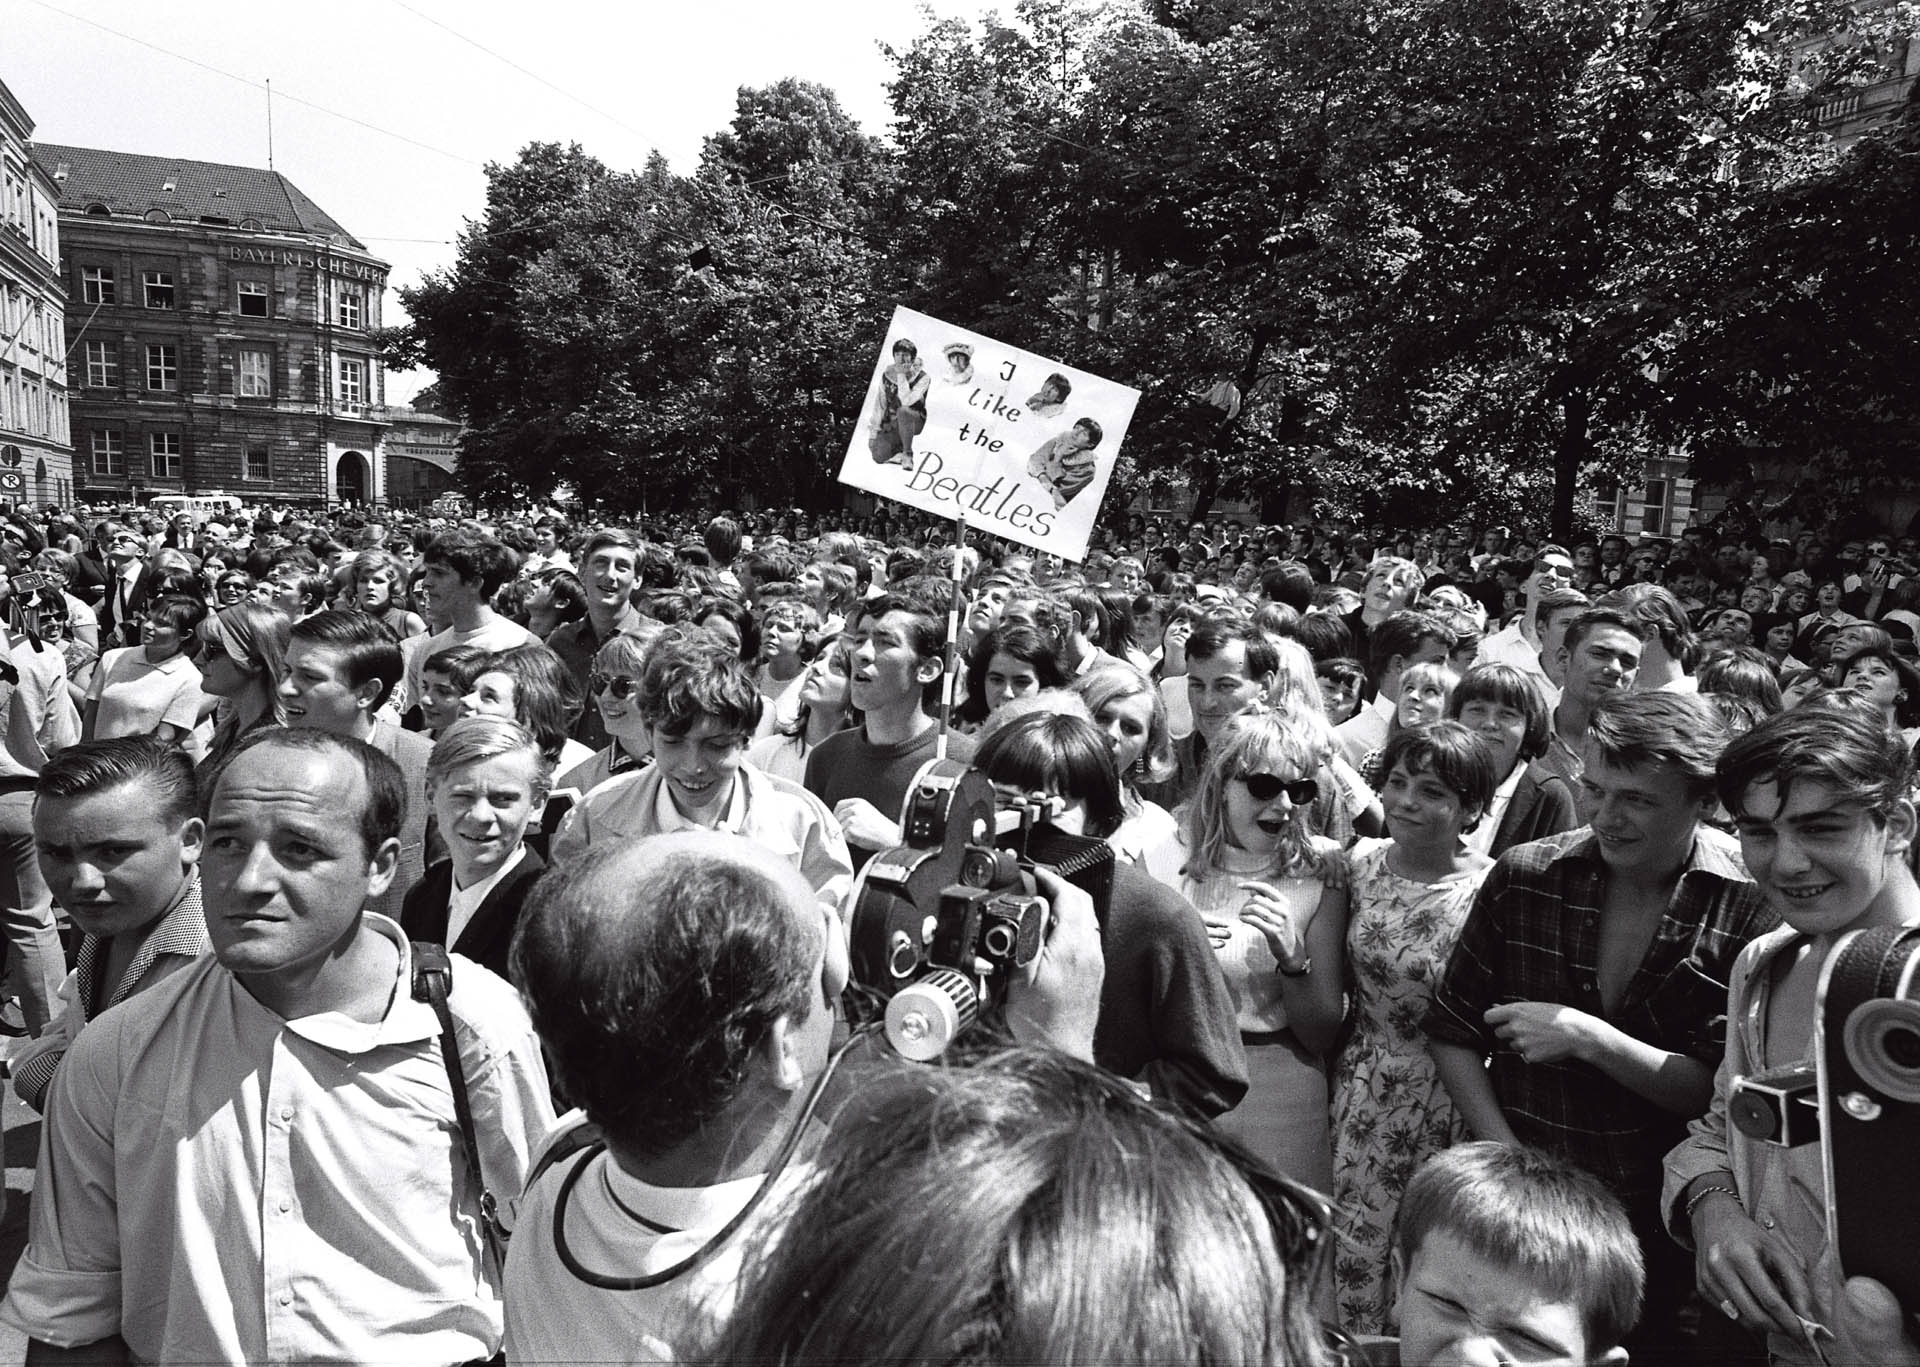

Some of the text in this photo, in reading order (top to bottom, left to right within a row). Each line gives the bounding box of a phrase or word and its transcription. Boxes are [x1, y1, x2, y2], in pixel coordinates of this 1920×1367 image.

[230, 246, 350, 275] BAYERISCHE
[968, 388, 1022, 422] like
[959, 423, 1004, 453] the
[904, 451, 1057, 537] Beatles
